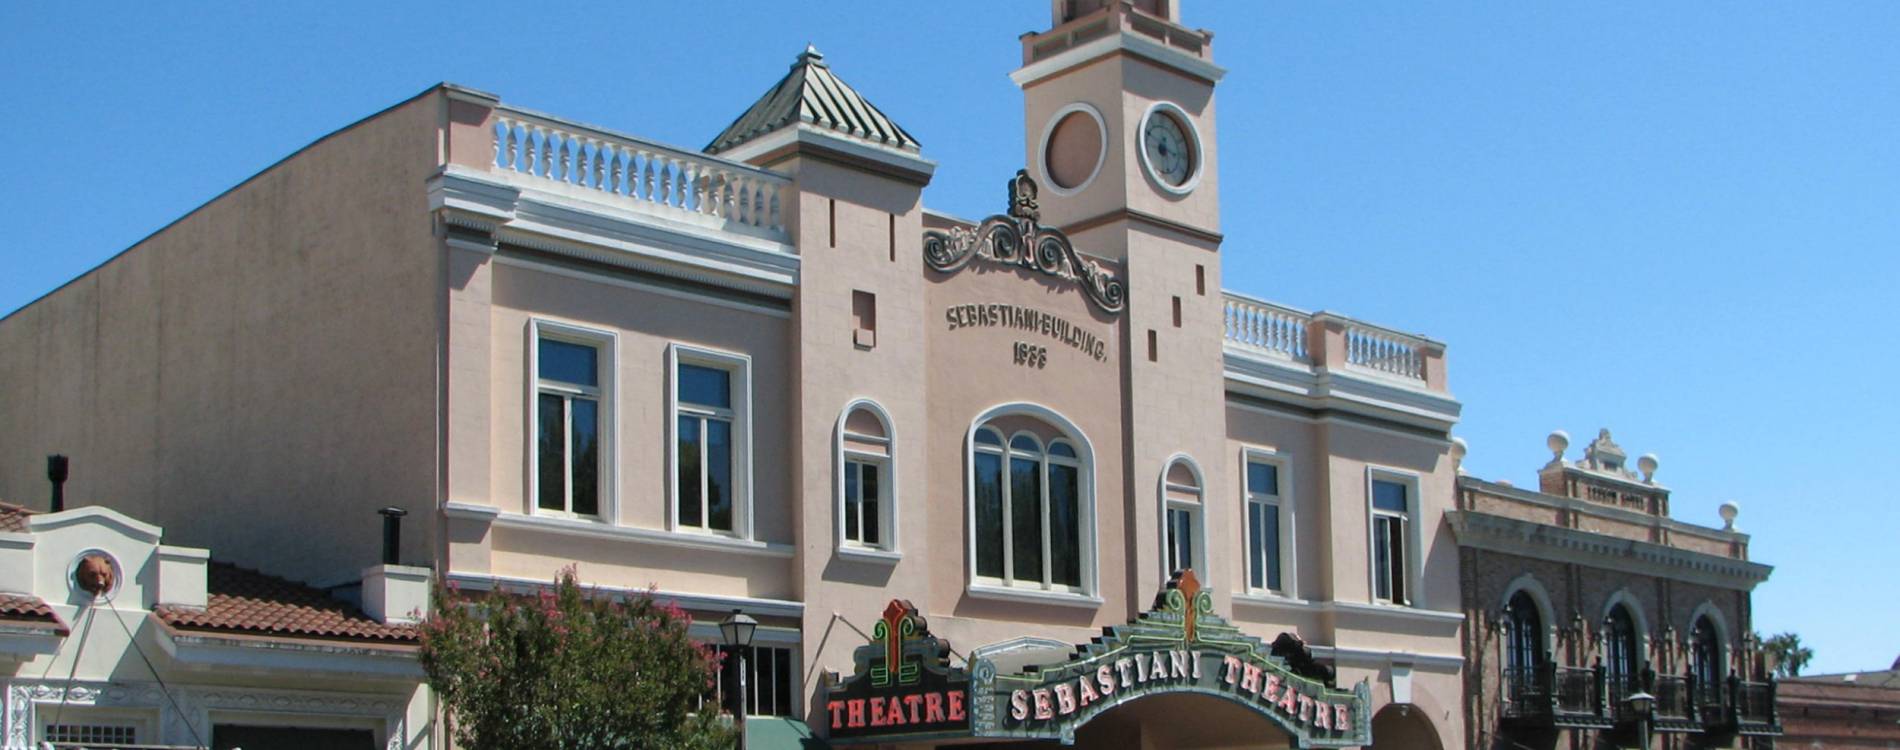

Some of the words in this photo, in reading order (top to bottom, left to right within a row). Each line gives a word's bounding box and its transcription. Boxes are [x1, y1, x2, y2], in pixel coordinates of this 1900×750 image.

[827, 690, 966, 728] THEATRE
[1011, 650, 1201, 721] SEBASTIANI
[1224, 655, 1350, 731] THEATRE
